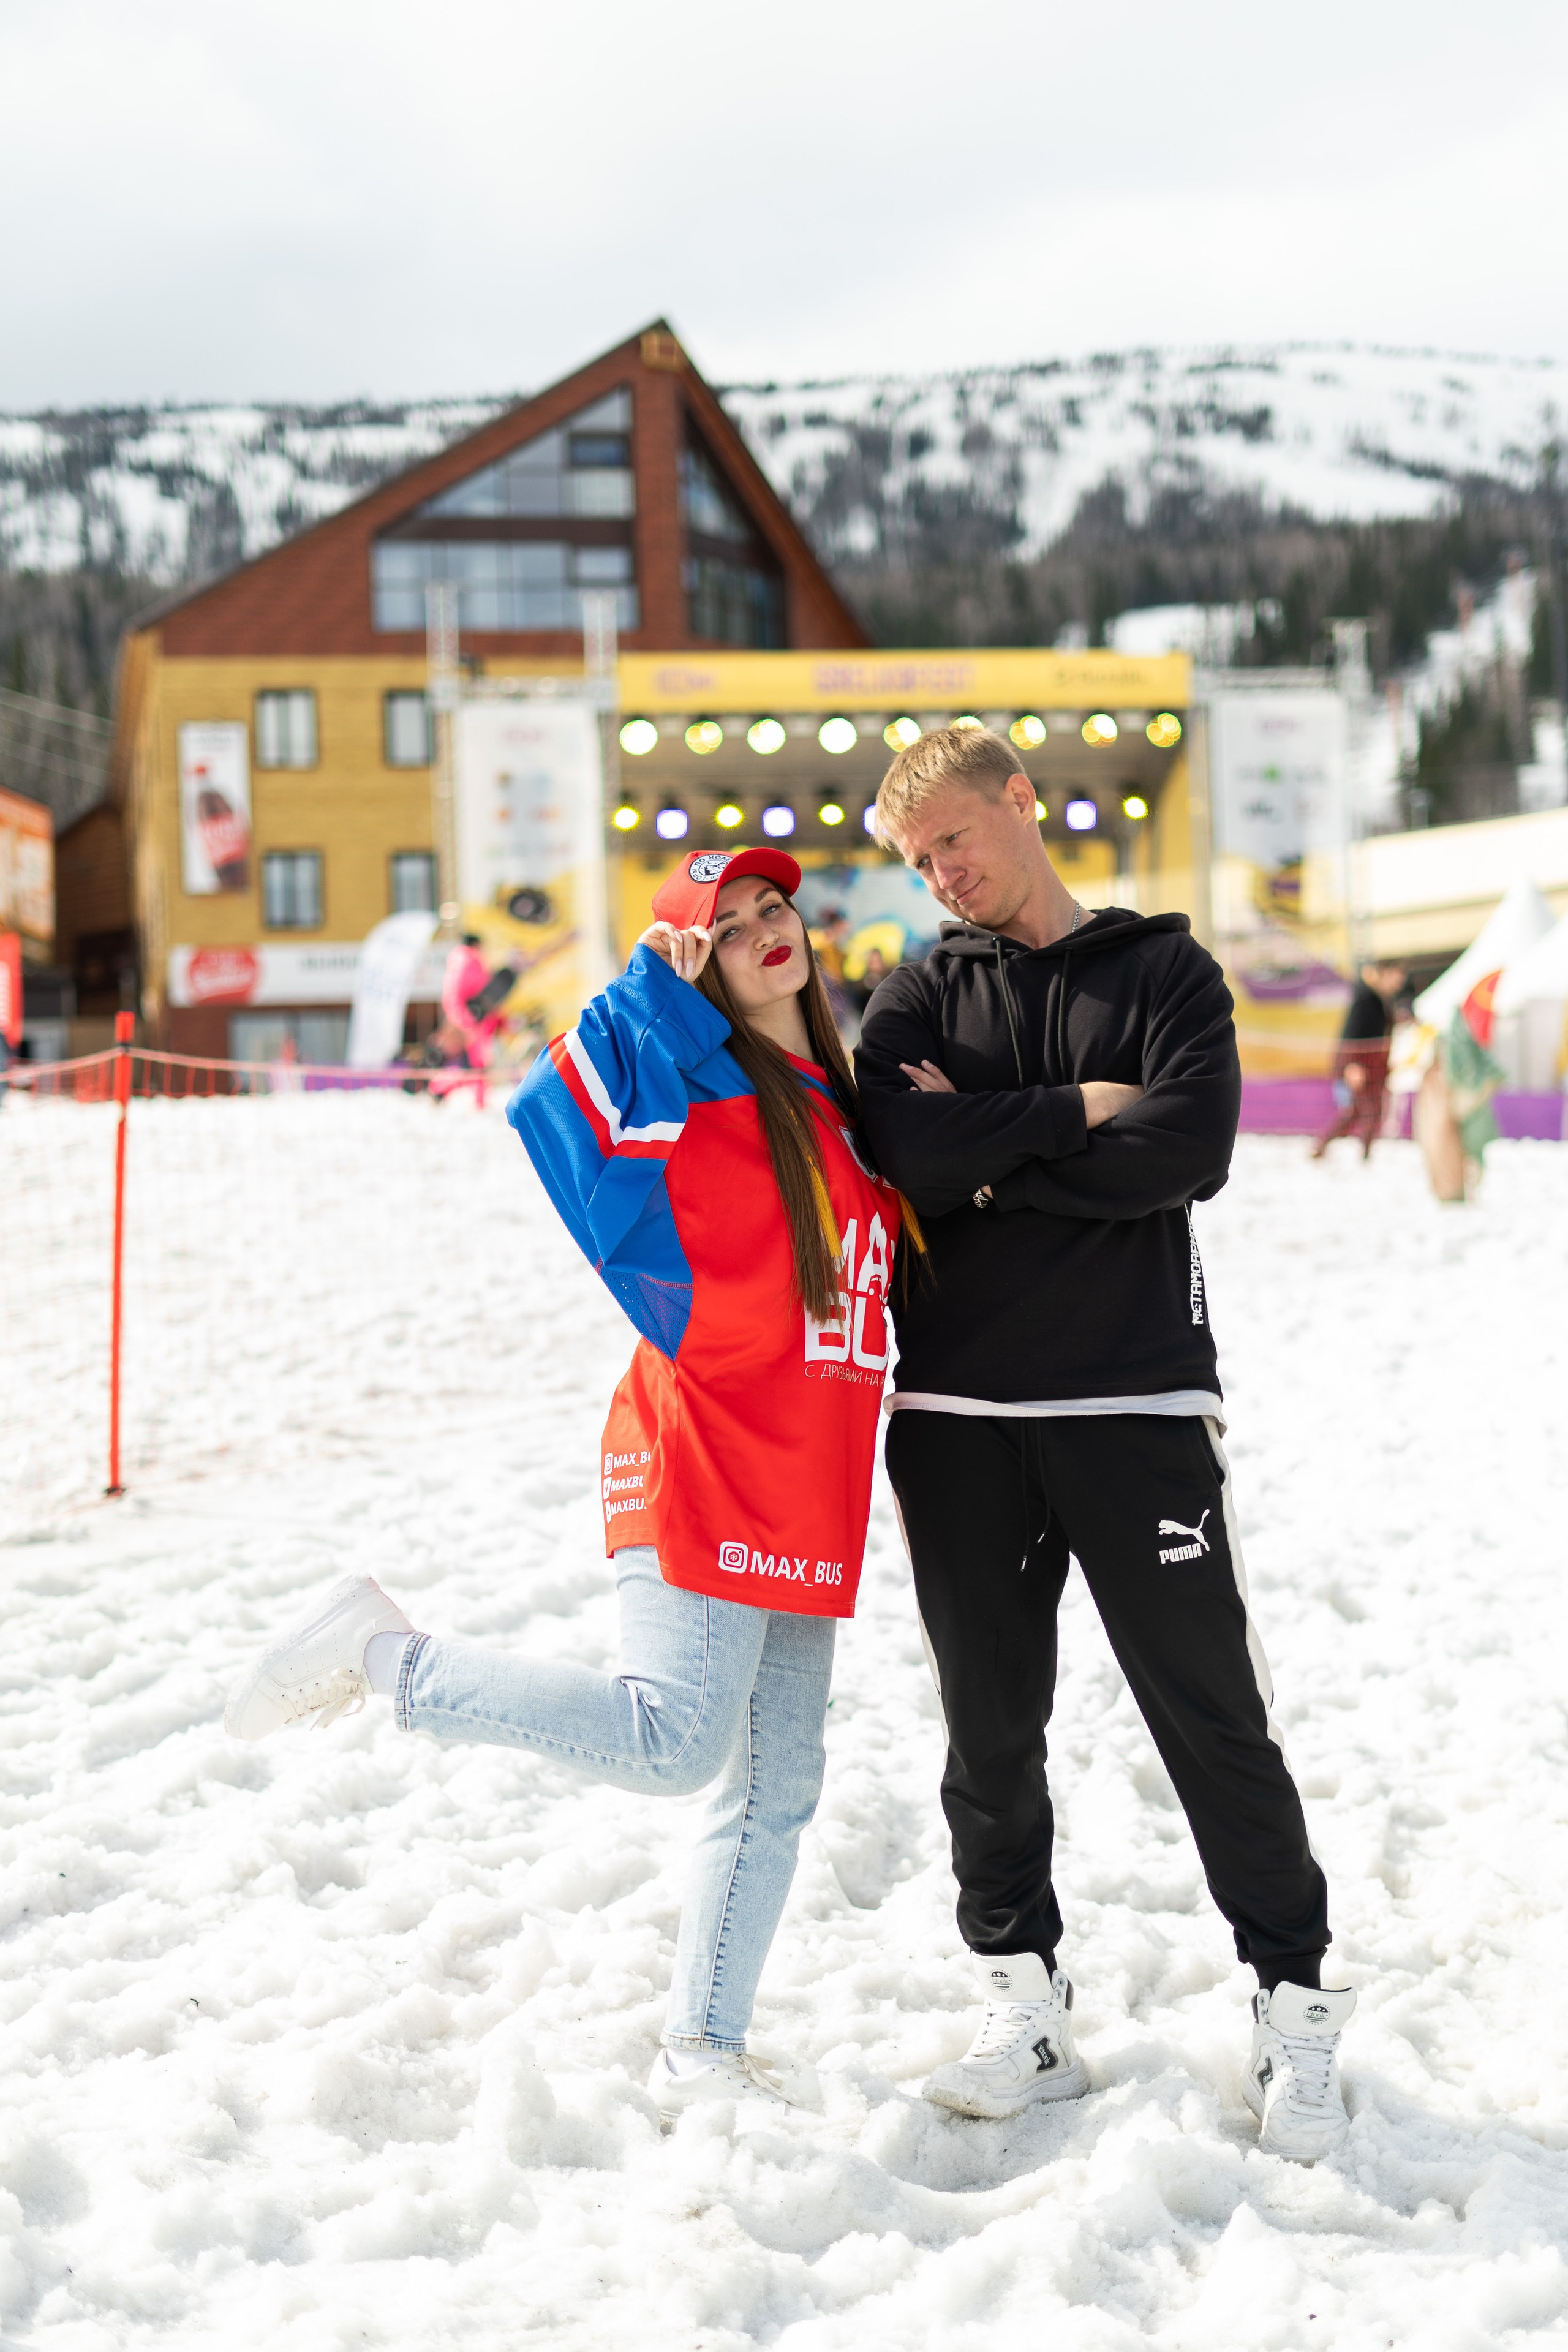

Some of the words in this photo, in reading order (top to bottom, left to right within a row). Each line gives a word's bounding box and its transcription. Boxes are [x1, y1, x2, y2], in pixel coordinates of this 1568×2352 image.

[820, 1211, 895, 1305] MA
[805, 1364, 815, 1377] С
[821, 1363, 862, 1384] ДРУЗЬЯМИ
[864, 1372, 879, 1387] НА
[1159, 1543, 1202, 1564] PUMA
[750, 1551, 842, 1586] MAX_BUS
[1038, 2044, 1050, 2066] Etonic
